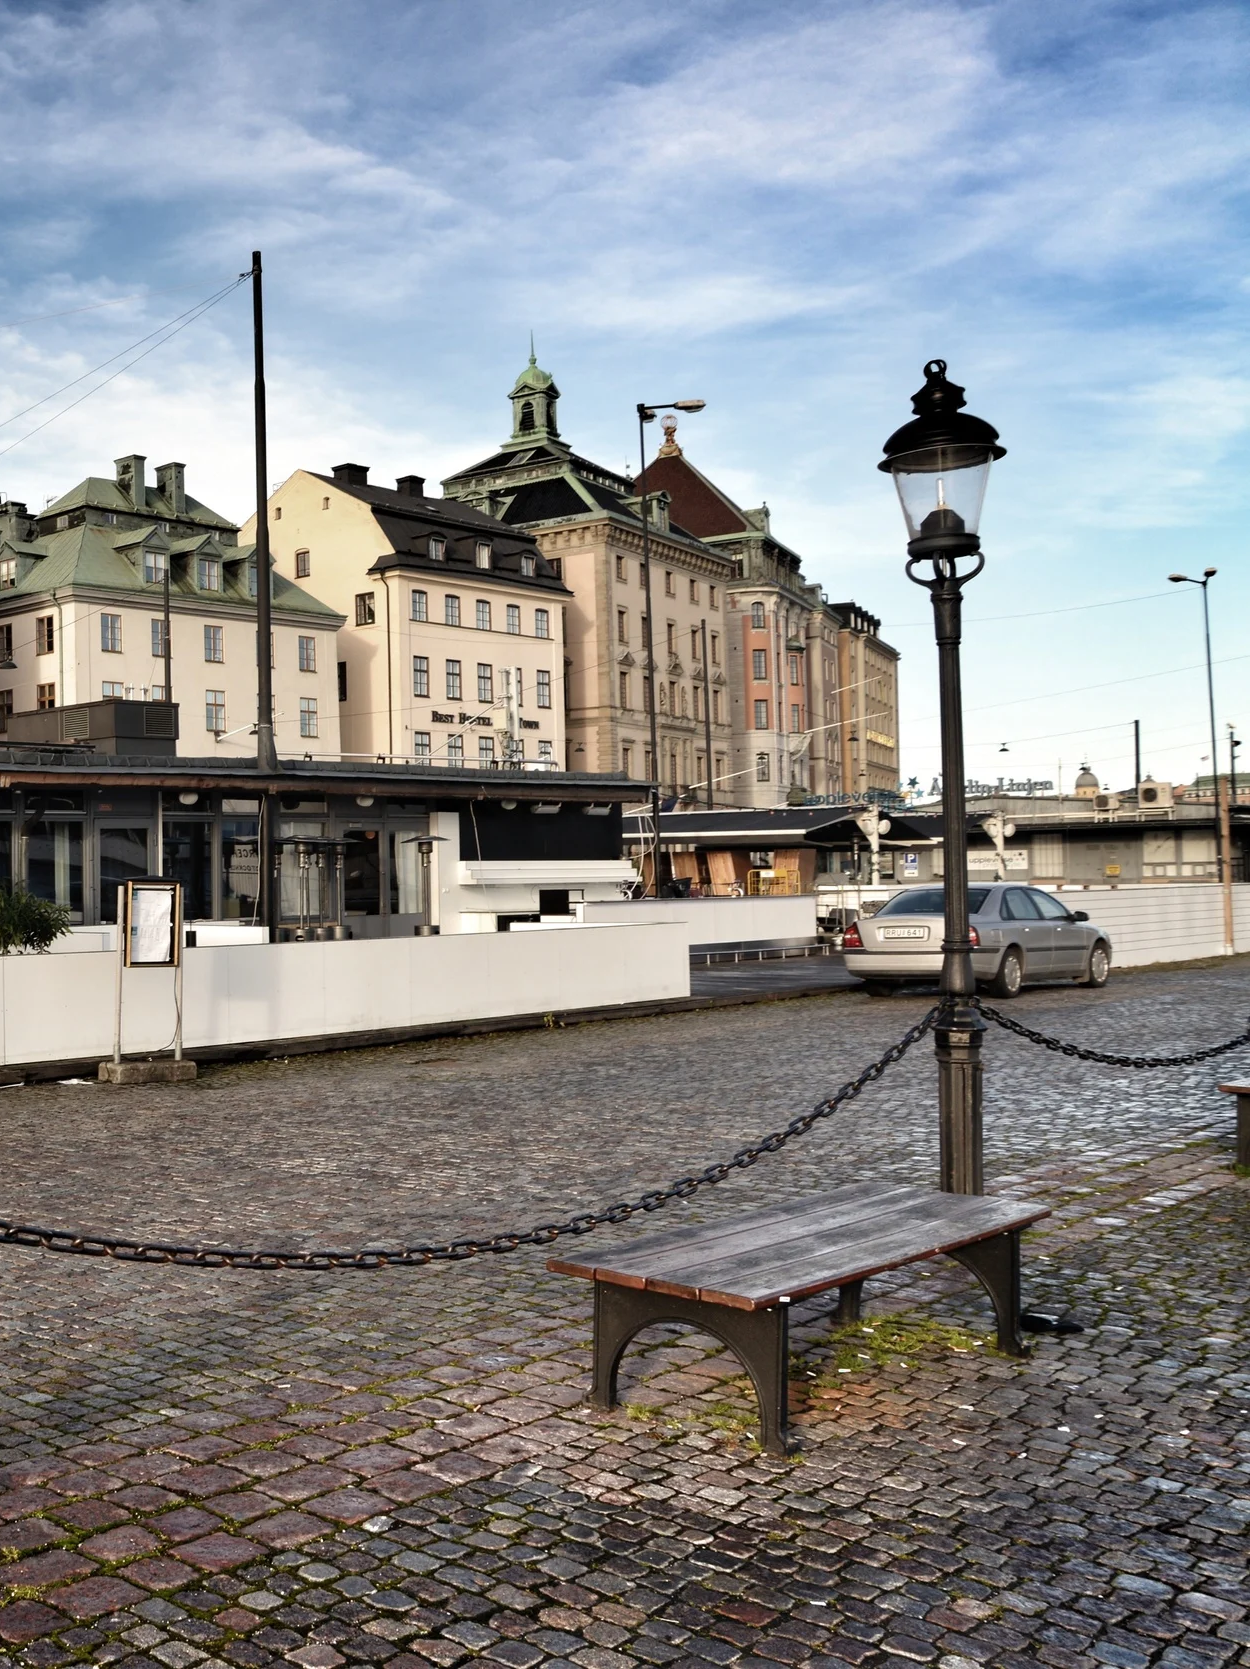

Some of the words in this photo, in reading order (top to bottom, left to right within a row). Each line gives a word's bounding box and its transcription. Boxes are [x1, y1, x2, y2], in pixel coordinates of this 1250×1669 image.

[431, 710, 454, 724] BEST
[907, 853, 915, 863] P
[886, 929, 902, 937] RRU
[906, 929, 921, 937] 641
